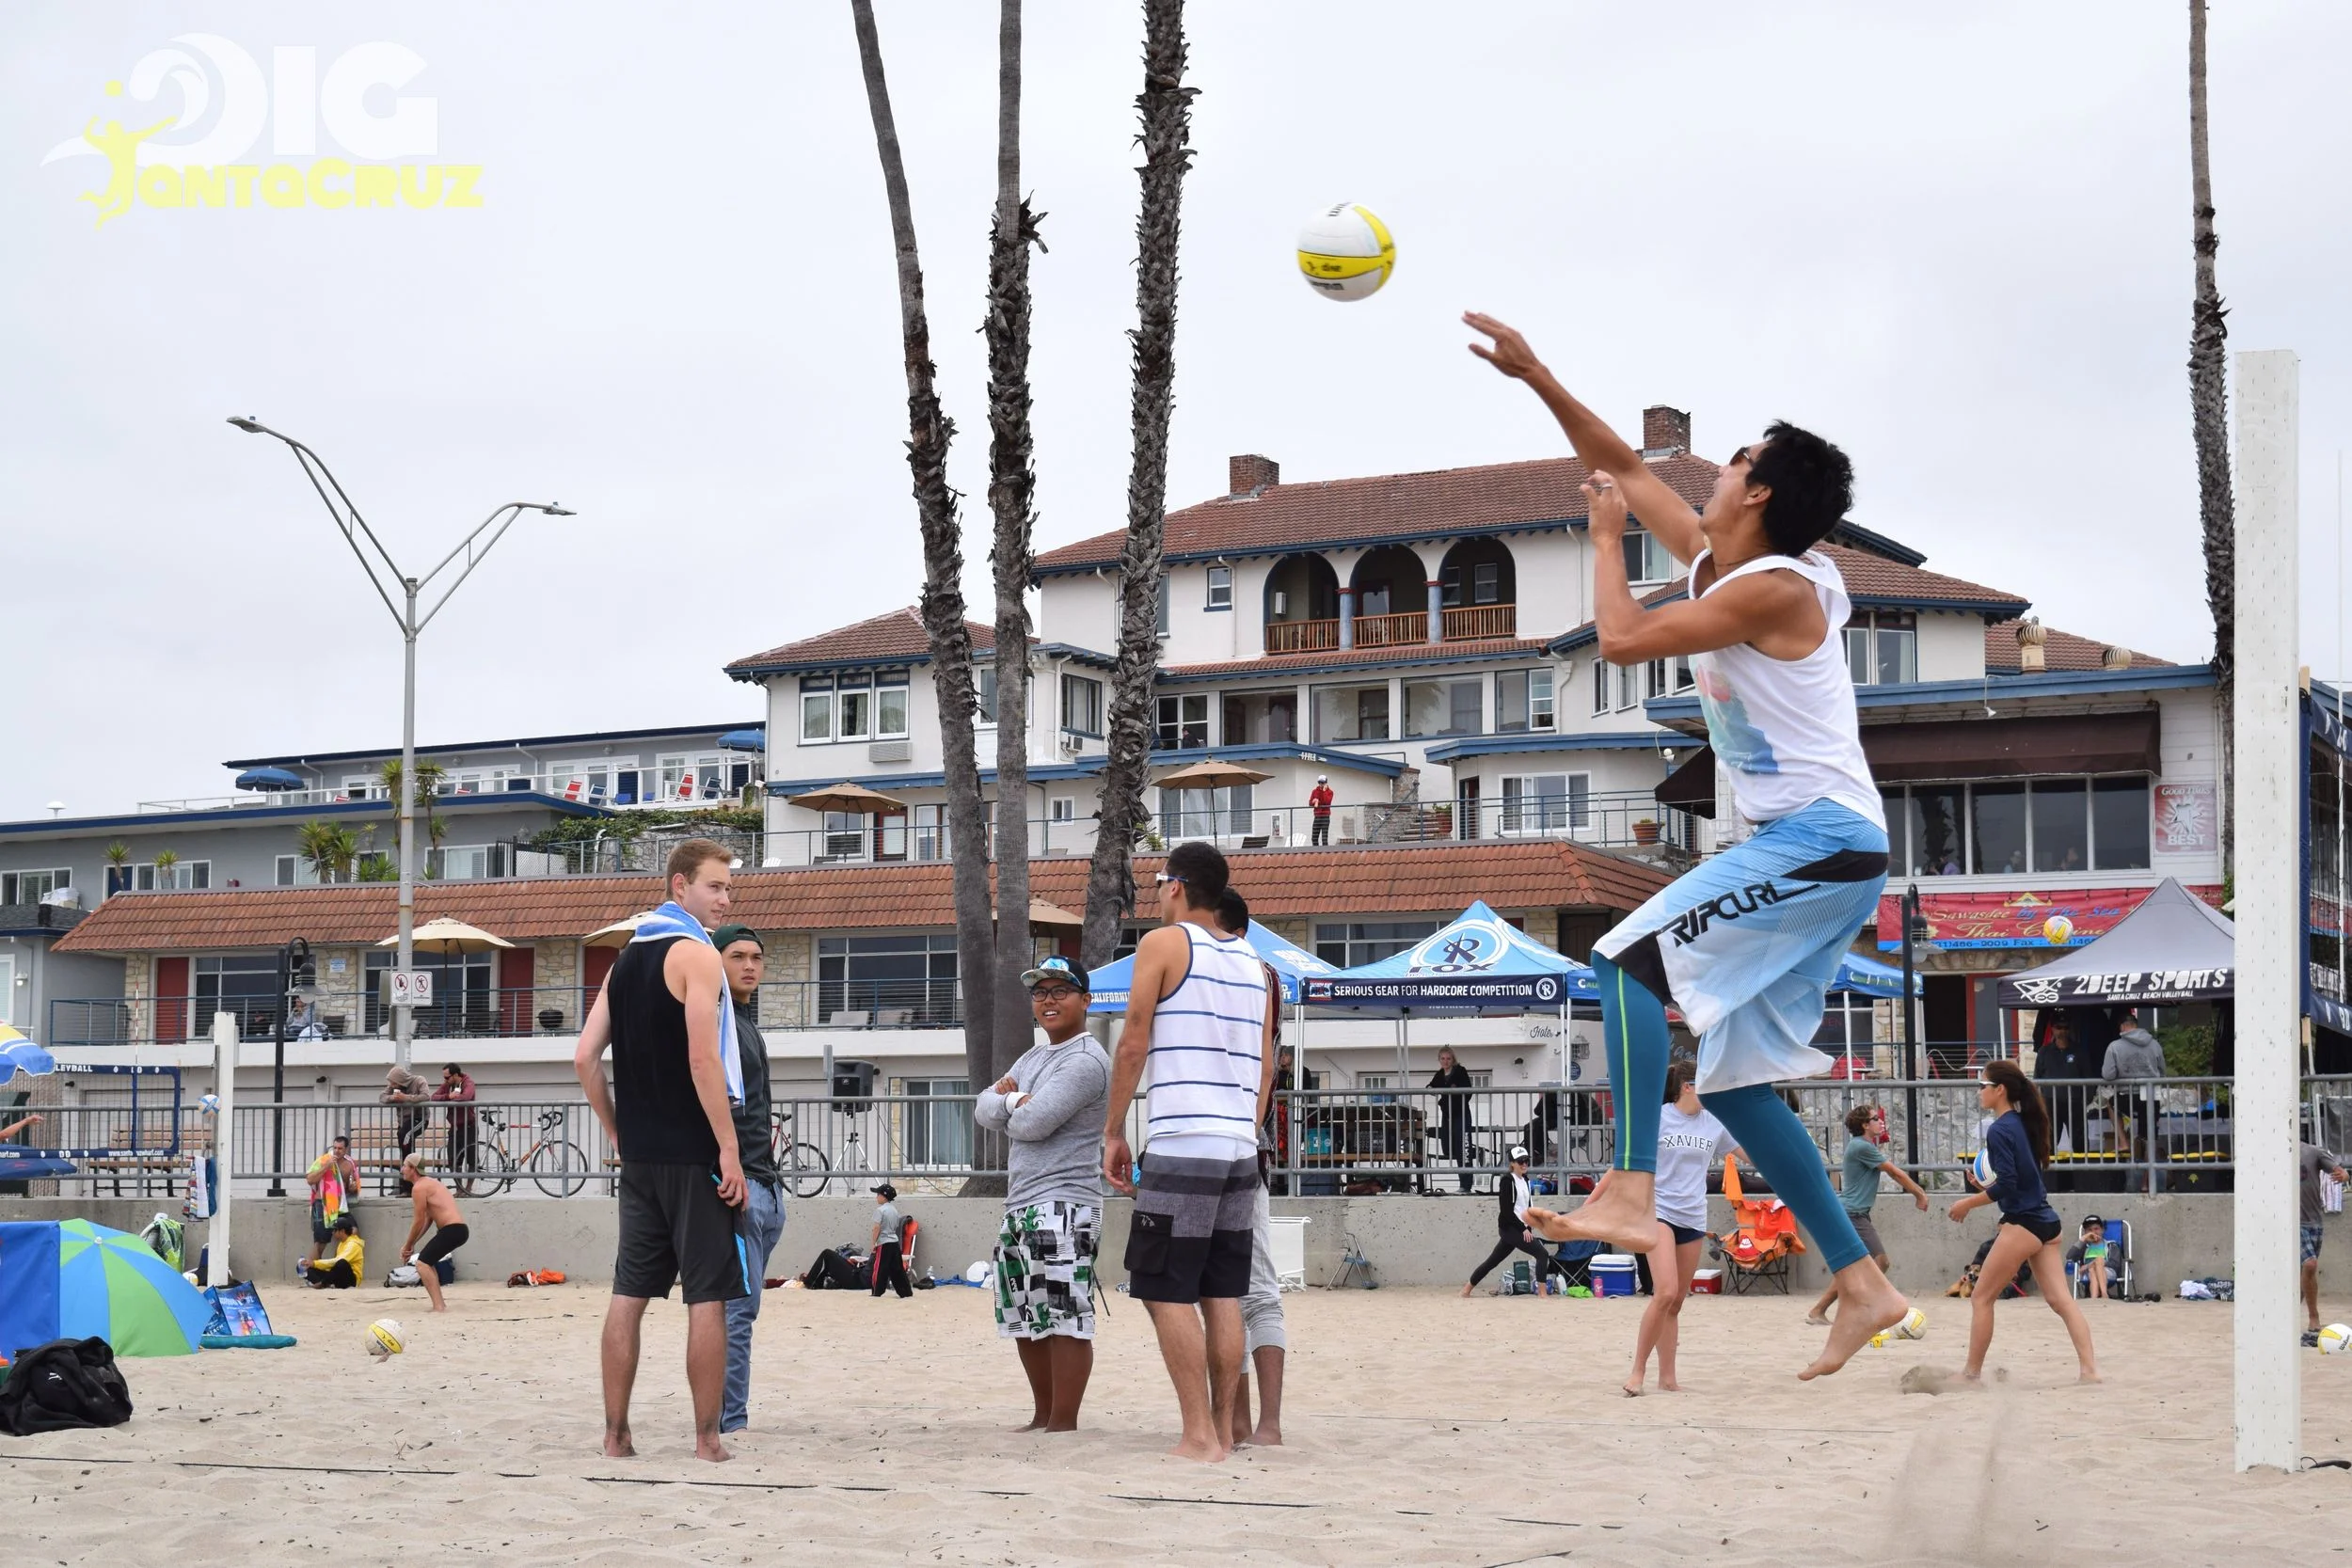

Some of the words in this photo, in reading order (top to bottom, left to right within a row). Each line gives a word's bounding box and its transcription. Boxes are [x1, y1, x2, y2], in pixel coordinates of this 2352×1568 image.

[2167, 833, 2206, 846] BEST
[1928, 909, 2010, 922] Sawasdee
[2016, 908, 2038, 922] by
[2045, 905, 2079, 917] The
[2086, 906, 2121, 918] Sea
[1951, 922, 2010, 939] Thai
[2016, 921, 2105, 937] Cine
[2073, 973, 2142, 995] 2DEEP
[2147, 968, 2229, 991] SPORTS
[1334, 985, 1374, 997] SERIOUS
[1375, 985, 1399, 997] GEAR
[1401, 985, 1419, 997] FOR
[1420, 985, 1469, 996] HARDCORE
[1470, 984, 1533, 996] COMPETITION
[2106, 993, 2125, 1002] SANTA
[2125, 992, 2141, 1001] CRUZ
[2142, 991, 2162, 1000] BEACH
[2162, 990, 2195, 999] VOLLEYBALL
[1090, 991, 1131, 1004] CALIFORNI
[56, 1064, 93, 1072] LEYBALL
[1664, 1134, 1713, 1150] XAVIER
